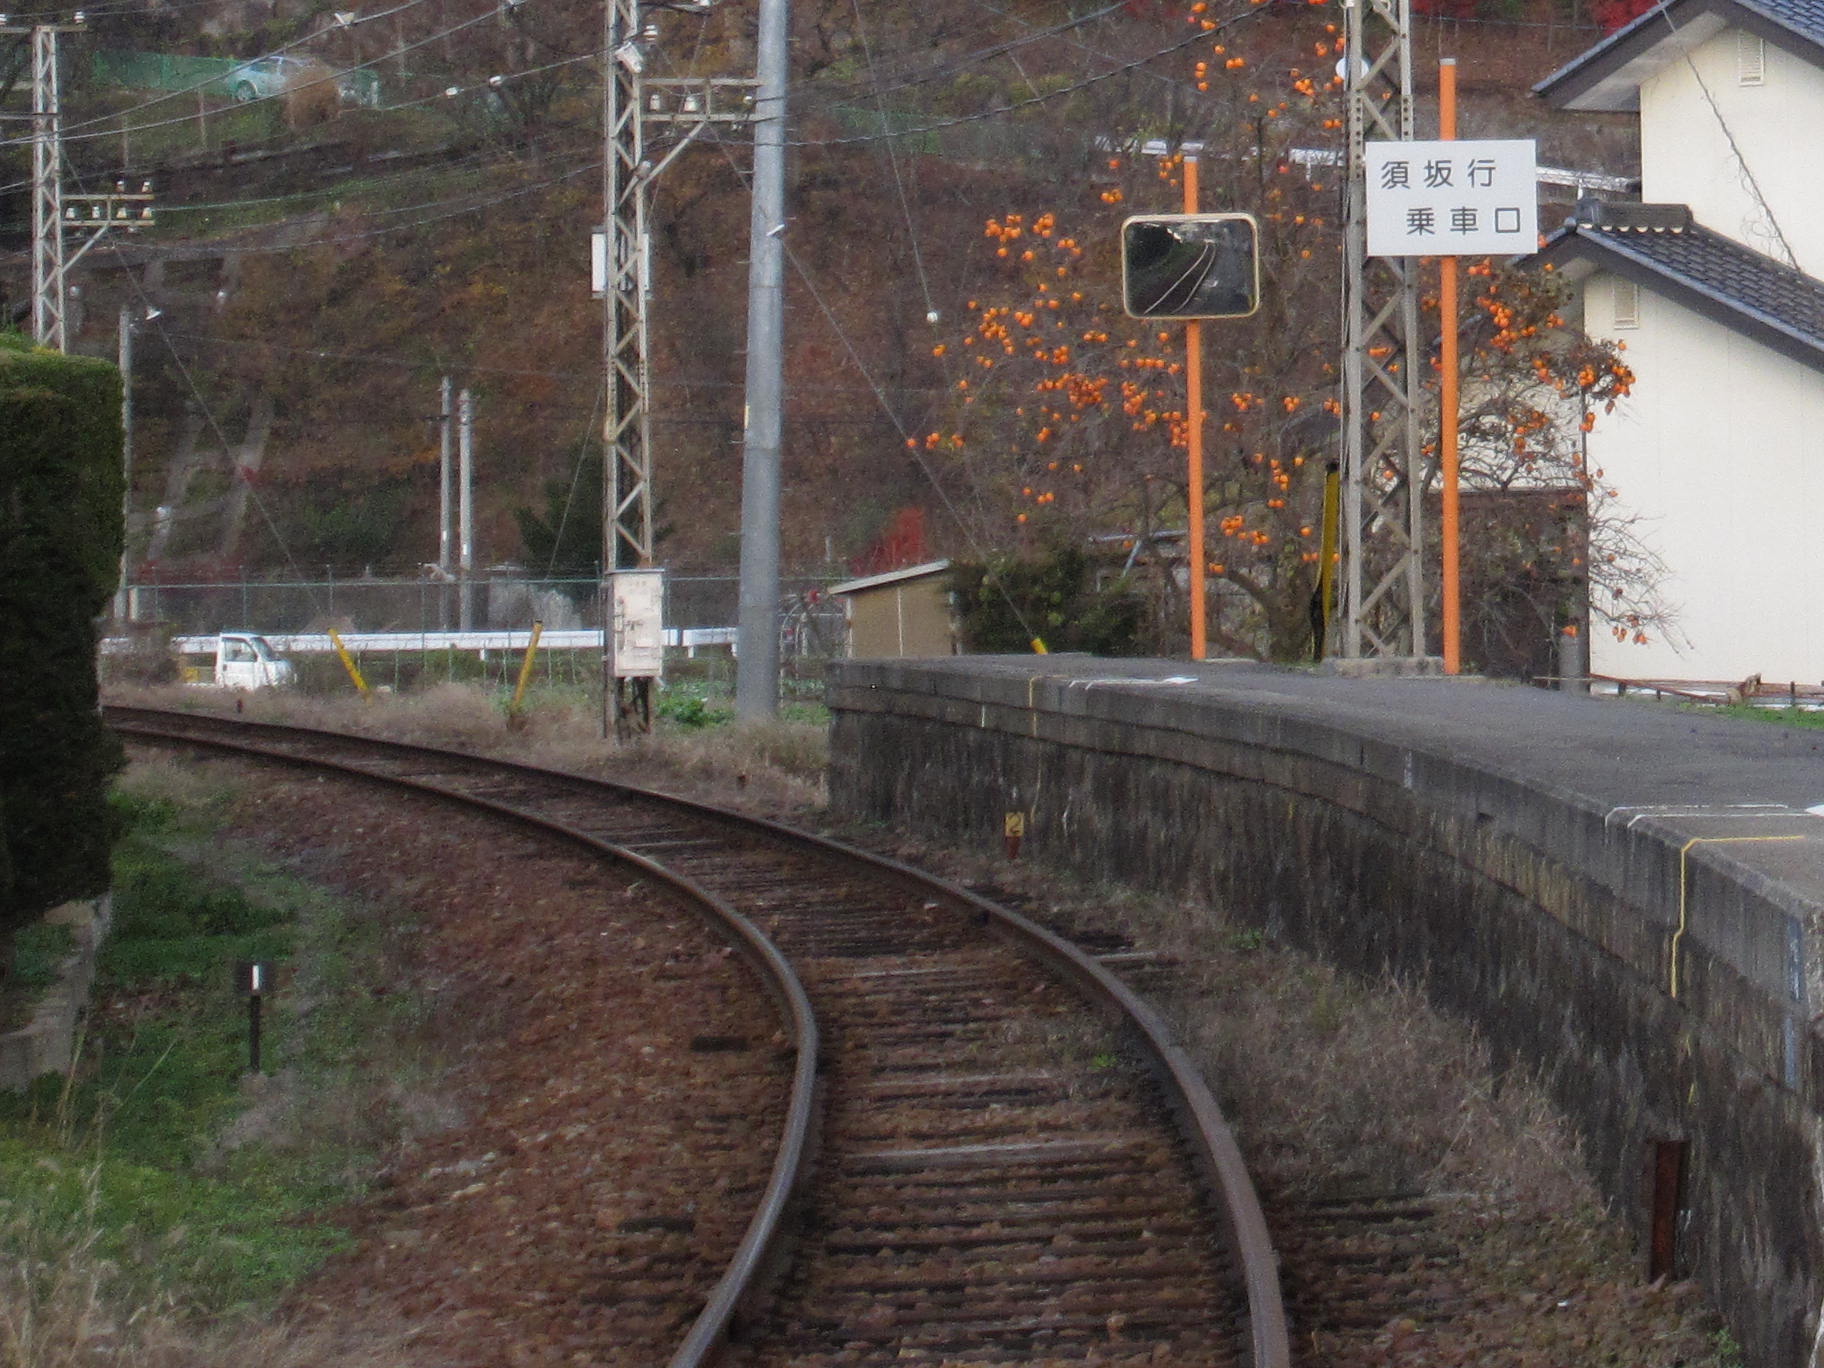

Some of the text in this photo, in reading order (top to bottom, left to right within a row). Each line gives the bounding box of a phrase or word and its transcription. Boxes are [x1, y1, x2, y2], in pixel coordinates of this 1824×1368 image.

[1381, 159, 1497, 190] 須坂行
[1406, 206, 1521, 236] 乗車口
